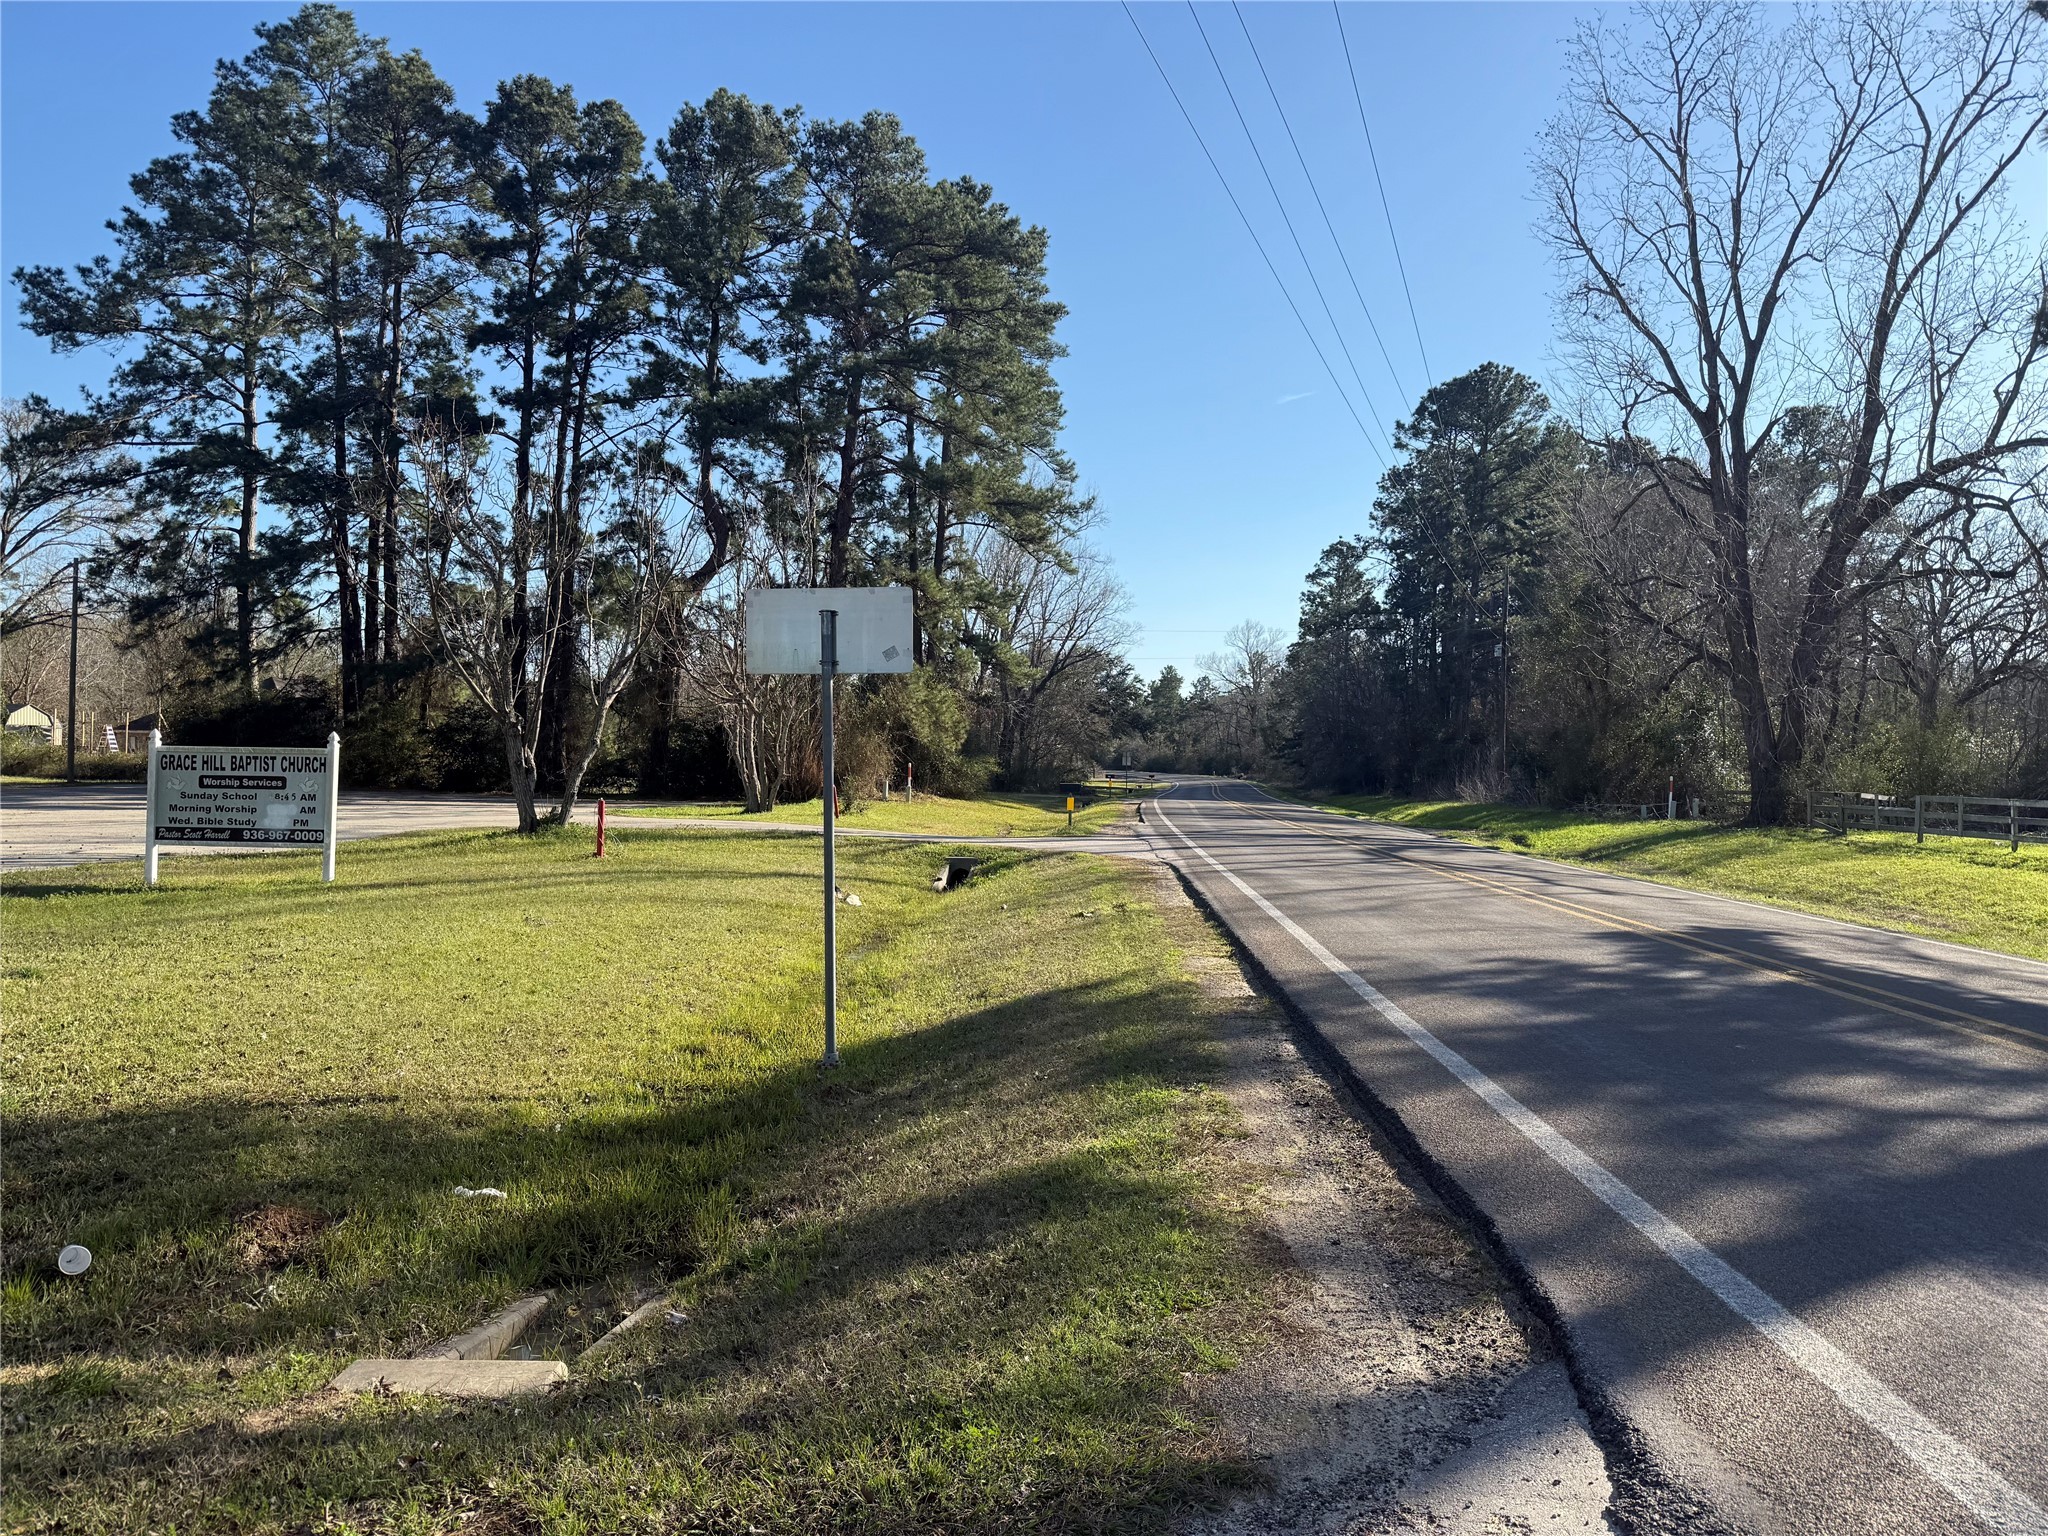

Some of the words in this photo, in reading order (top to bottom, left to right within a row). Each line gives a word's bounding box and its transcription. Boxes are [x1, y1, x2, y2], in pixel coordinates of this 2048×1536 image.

[160, 754, 197, 771] GRACE
[201, 755, 226, 771] HILL
[231, 756, 277, 773] BAPTIST
[281, 756, 327, 773] CHURCH
[203, 778, 240, 787] Worship
[242, 779, 282, 787] Services
[180, 792, 219, 801] Sunday
[222, 792, 257, 801] School
[169, 804, 211, 814] Morning
[215, 805, 257, 815] Worship
[168, 817, 193, 825] Wed.
[197, 818, 224, 826] Bible
[227, 818, 257, 827] Study
[293, 819, 309, 827] PM
[158, 828, 181, 839] Pastor
[183, 829, 203, 839] Scott
[204, 829, 230, 839] Harrell
[243, 830, 323, 841] 936-967-0009
